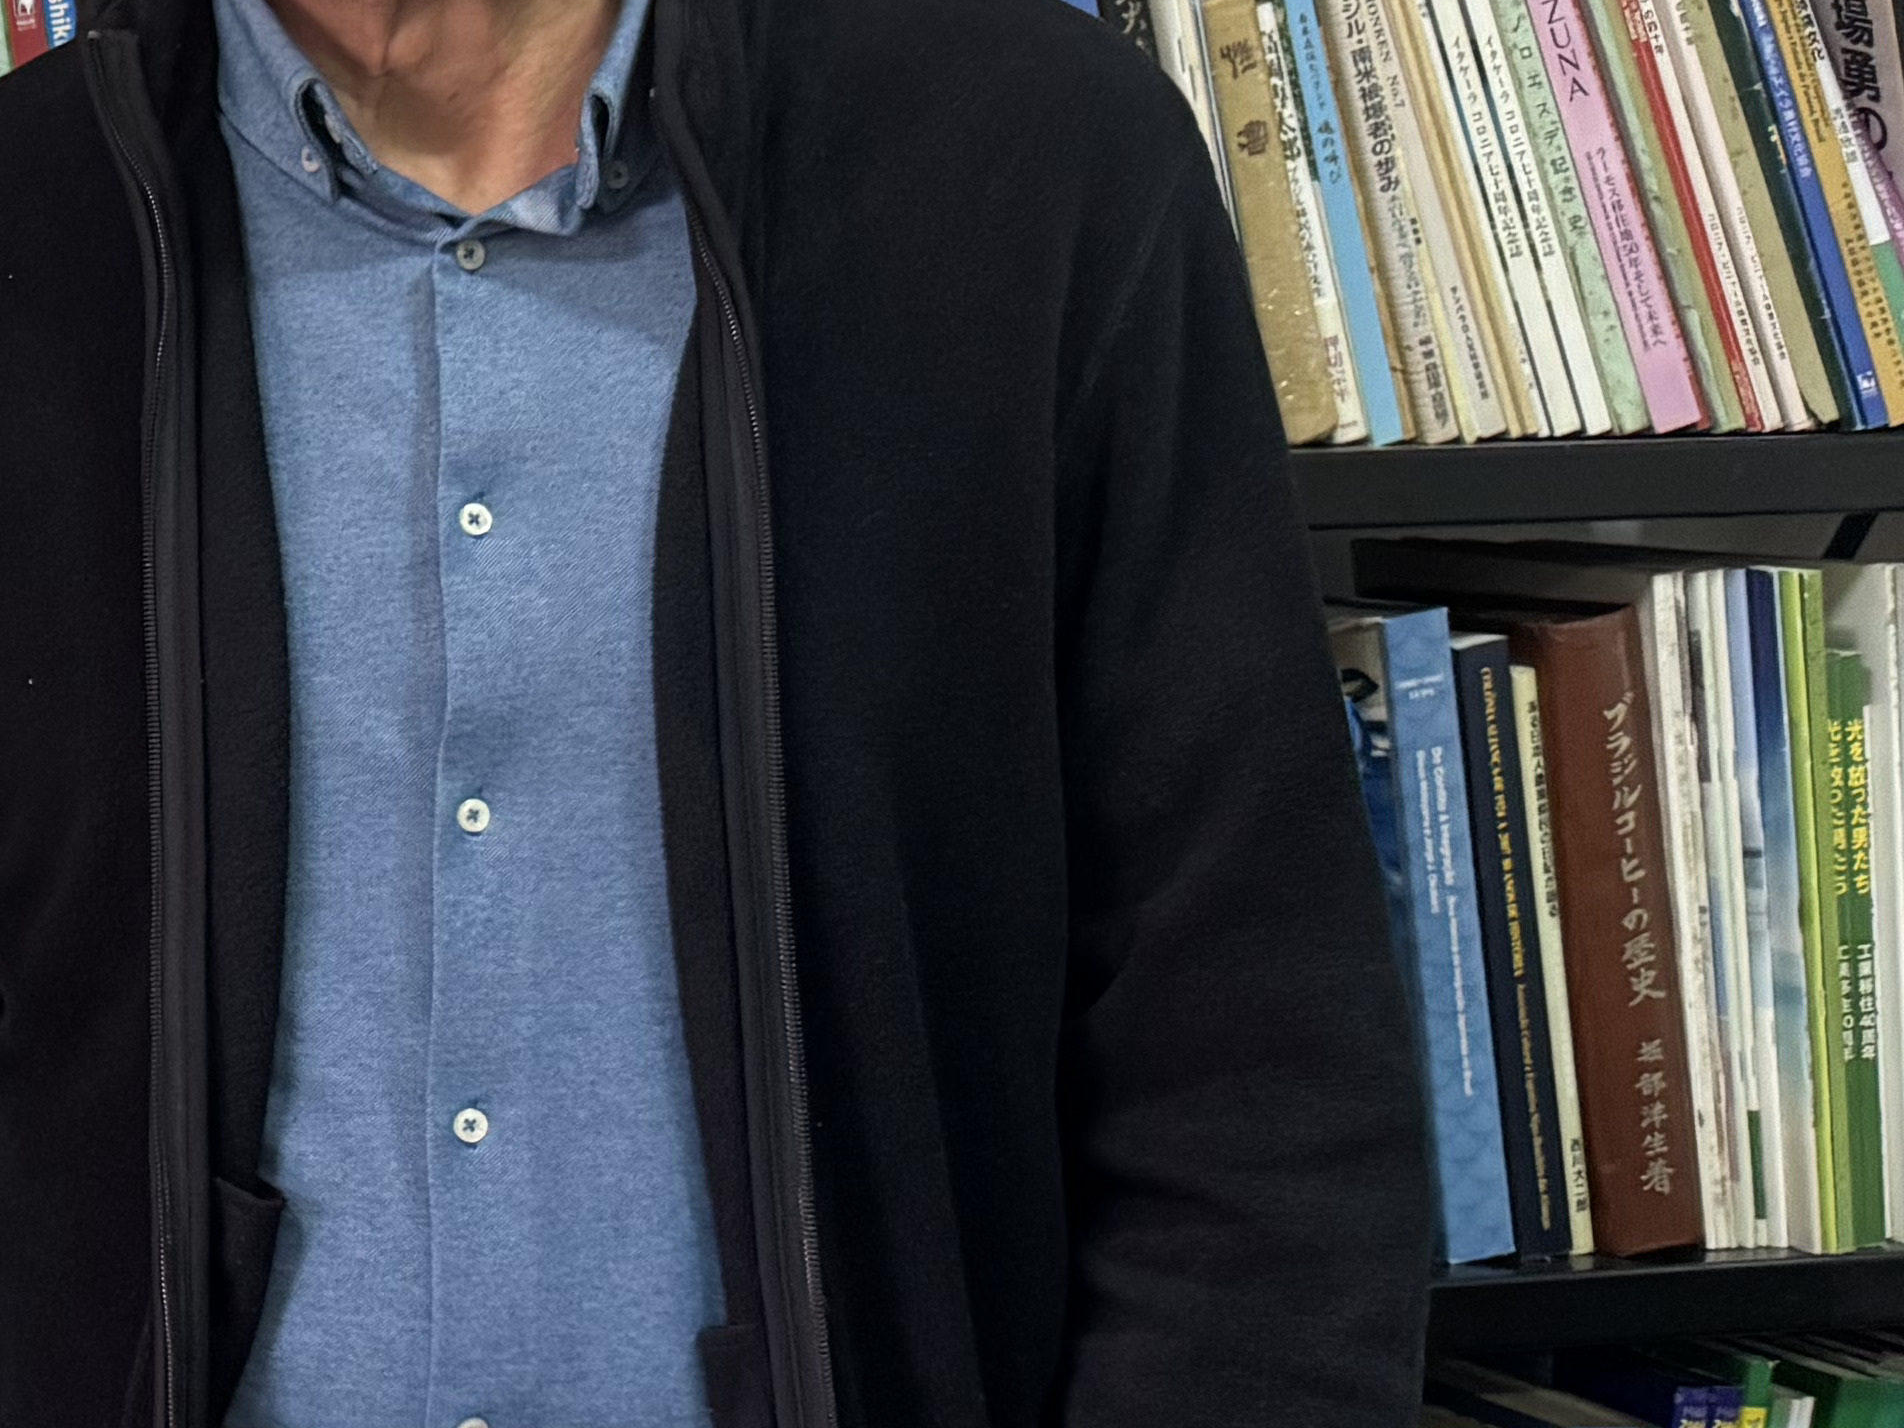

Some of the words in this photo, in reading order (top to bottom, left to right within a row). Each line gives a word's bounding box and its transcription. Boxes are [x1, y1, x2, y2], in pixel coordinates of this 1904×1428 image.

[1604, 691, 1667, 1007] ブラジルコーヒーの歴史
[1845, 718, 1873, 897] 光を放った男たち
